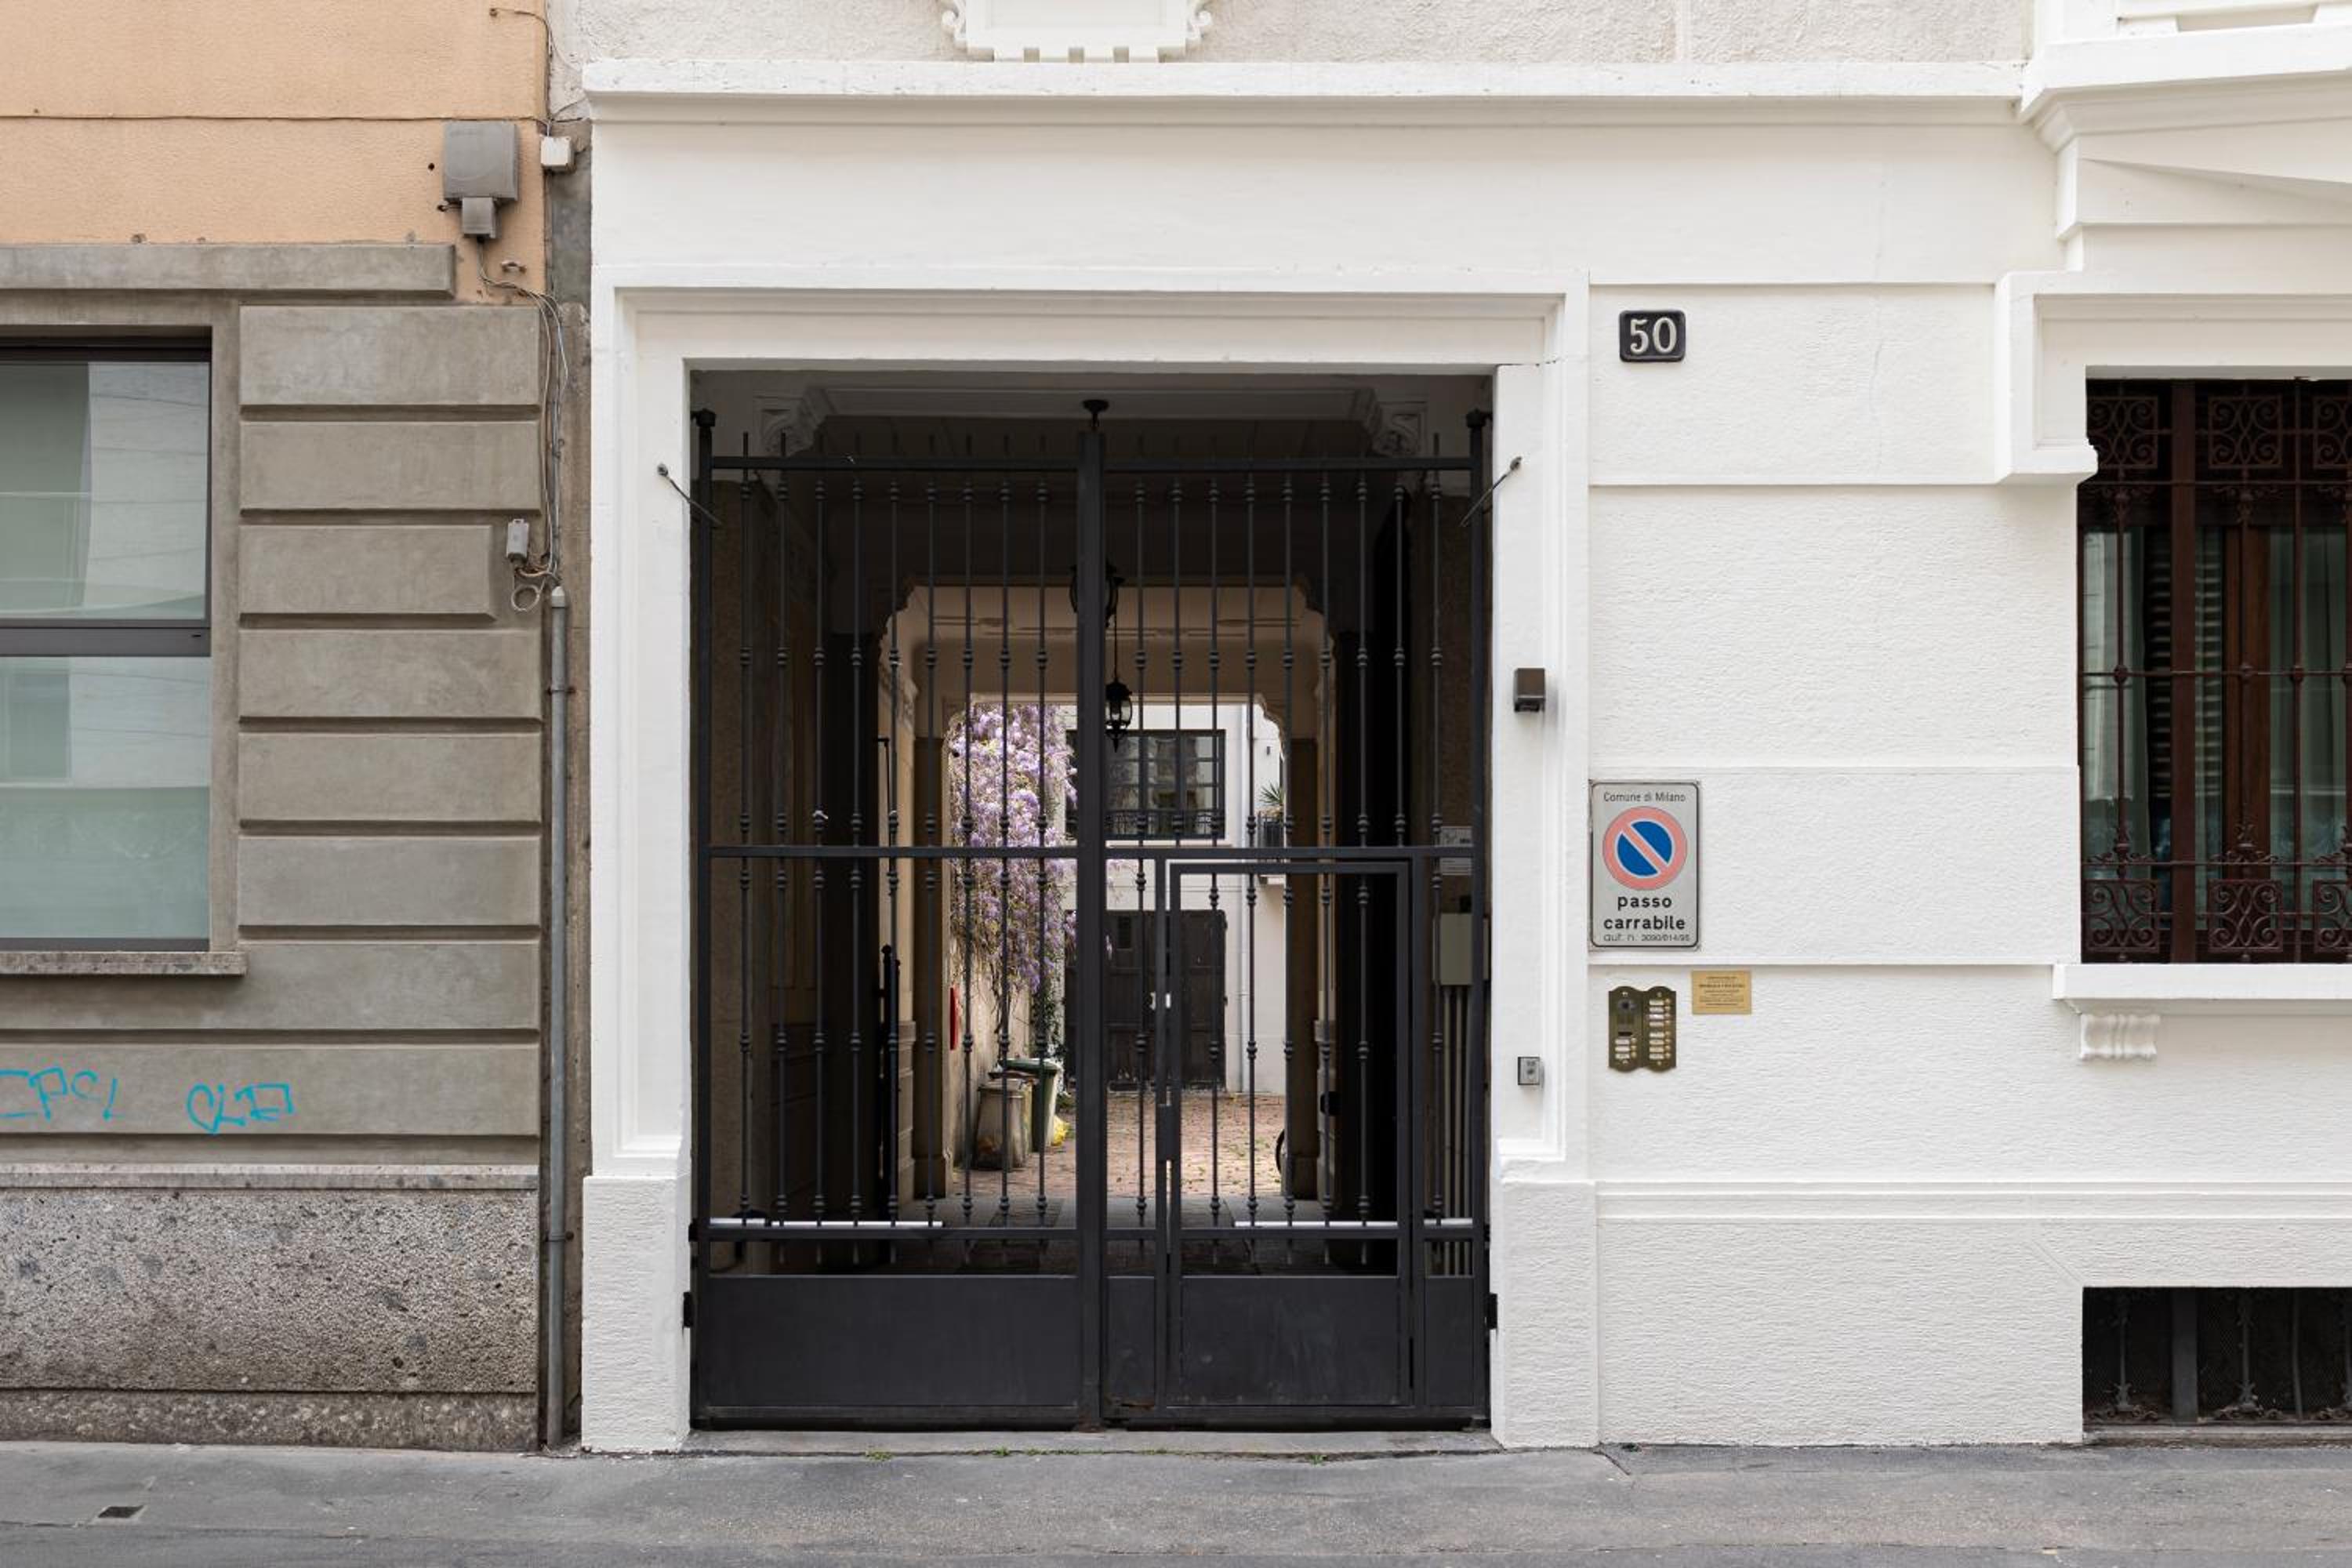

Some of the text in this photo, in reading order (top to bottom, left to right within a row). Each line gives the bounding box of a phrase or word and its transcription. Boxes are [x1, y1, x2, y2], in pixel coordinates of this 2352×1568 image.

[1630, 317, 1677, 354] 50
[1603, 791, 1686, 802] Comune di Milano
[1617, 896, 1672, 911] passo
[1603, 915, 1685, 930] carrabile
